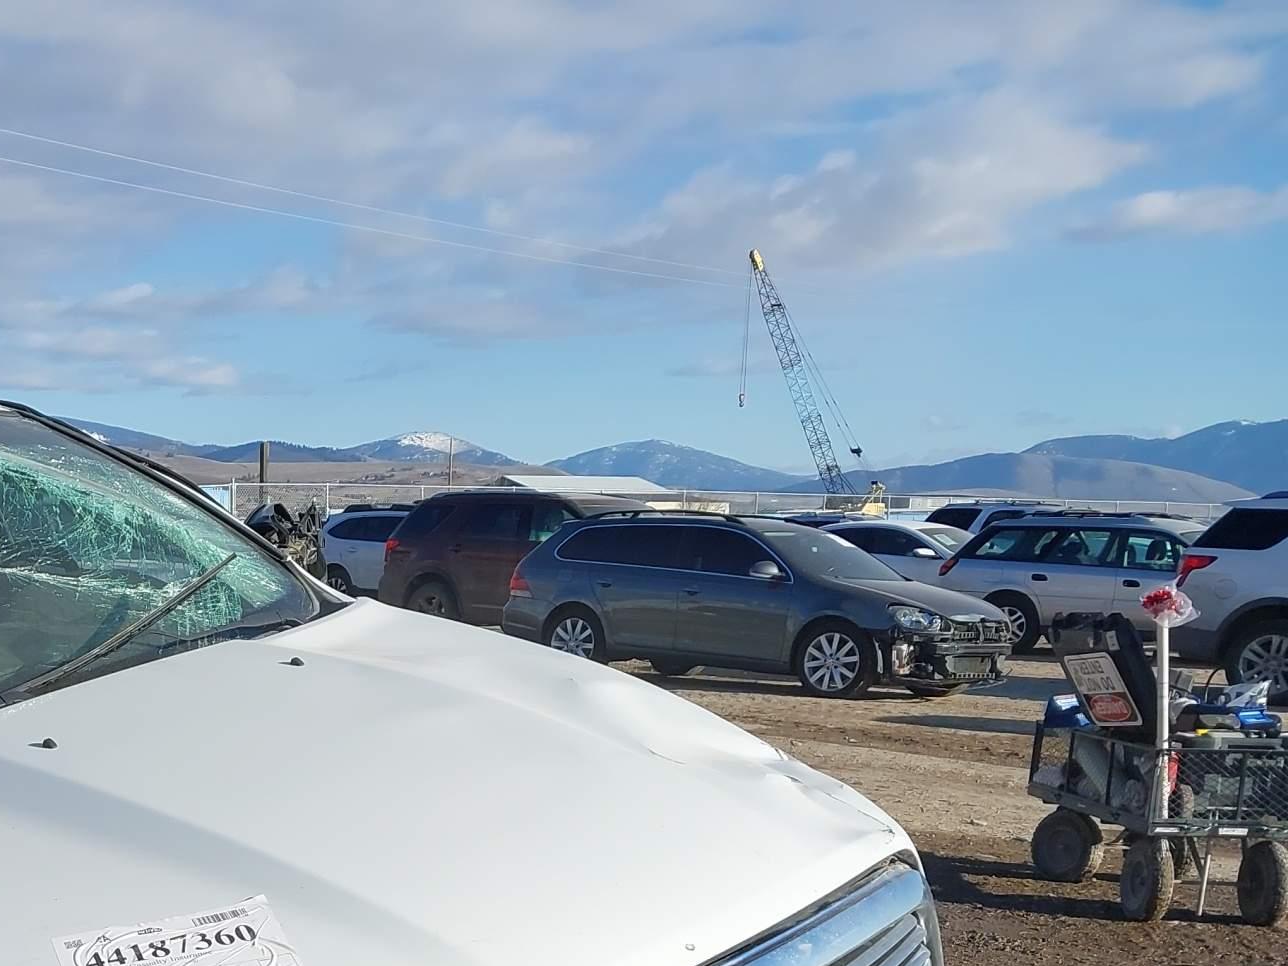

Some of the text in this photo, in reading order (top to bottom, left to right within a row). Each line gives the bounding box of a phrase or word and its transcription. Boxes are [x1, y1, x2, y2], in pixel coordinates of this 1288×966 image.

[1079, 661, 1104, 674] ENTER
[1084, 677, 1115, 690] DO NOT
